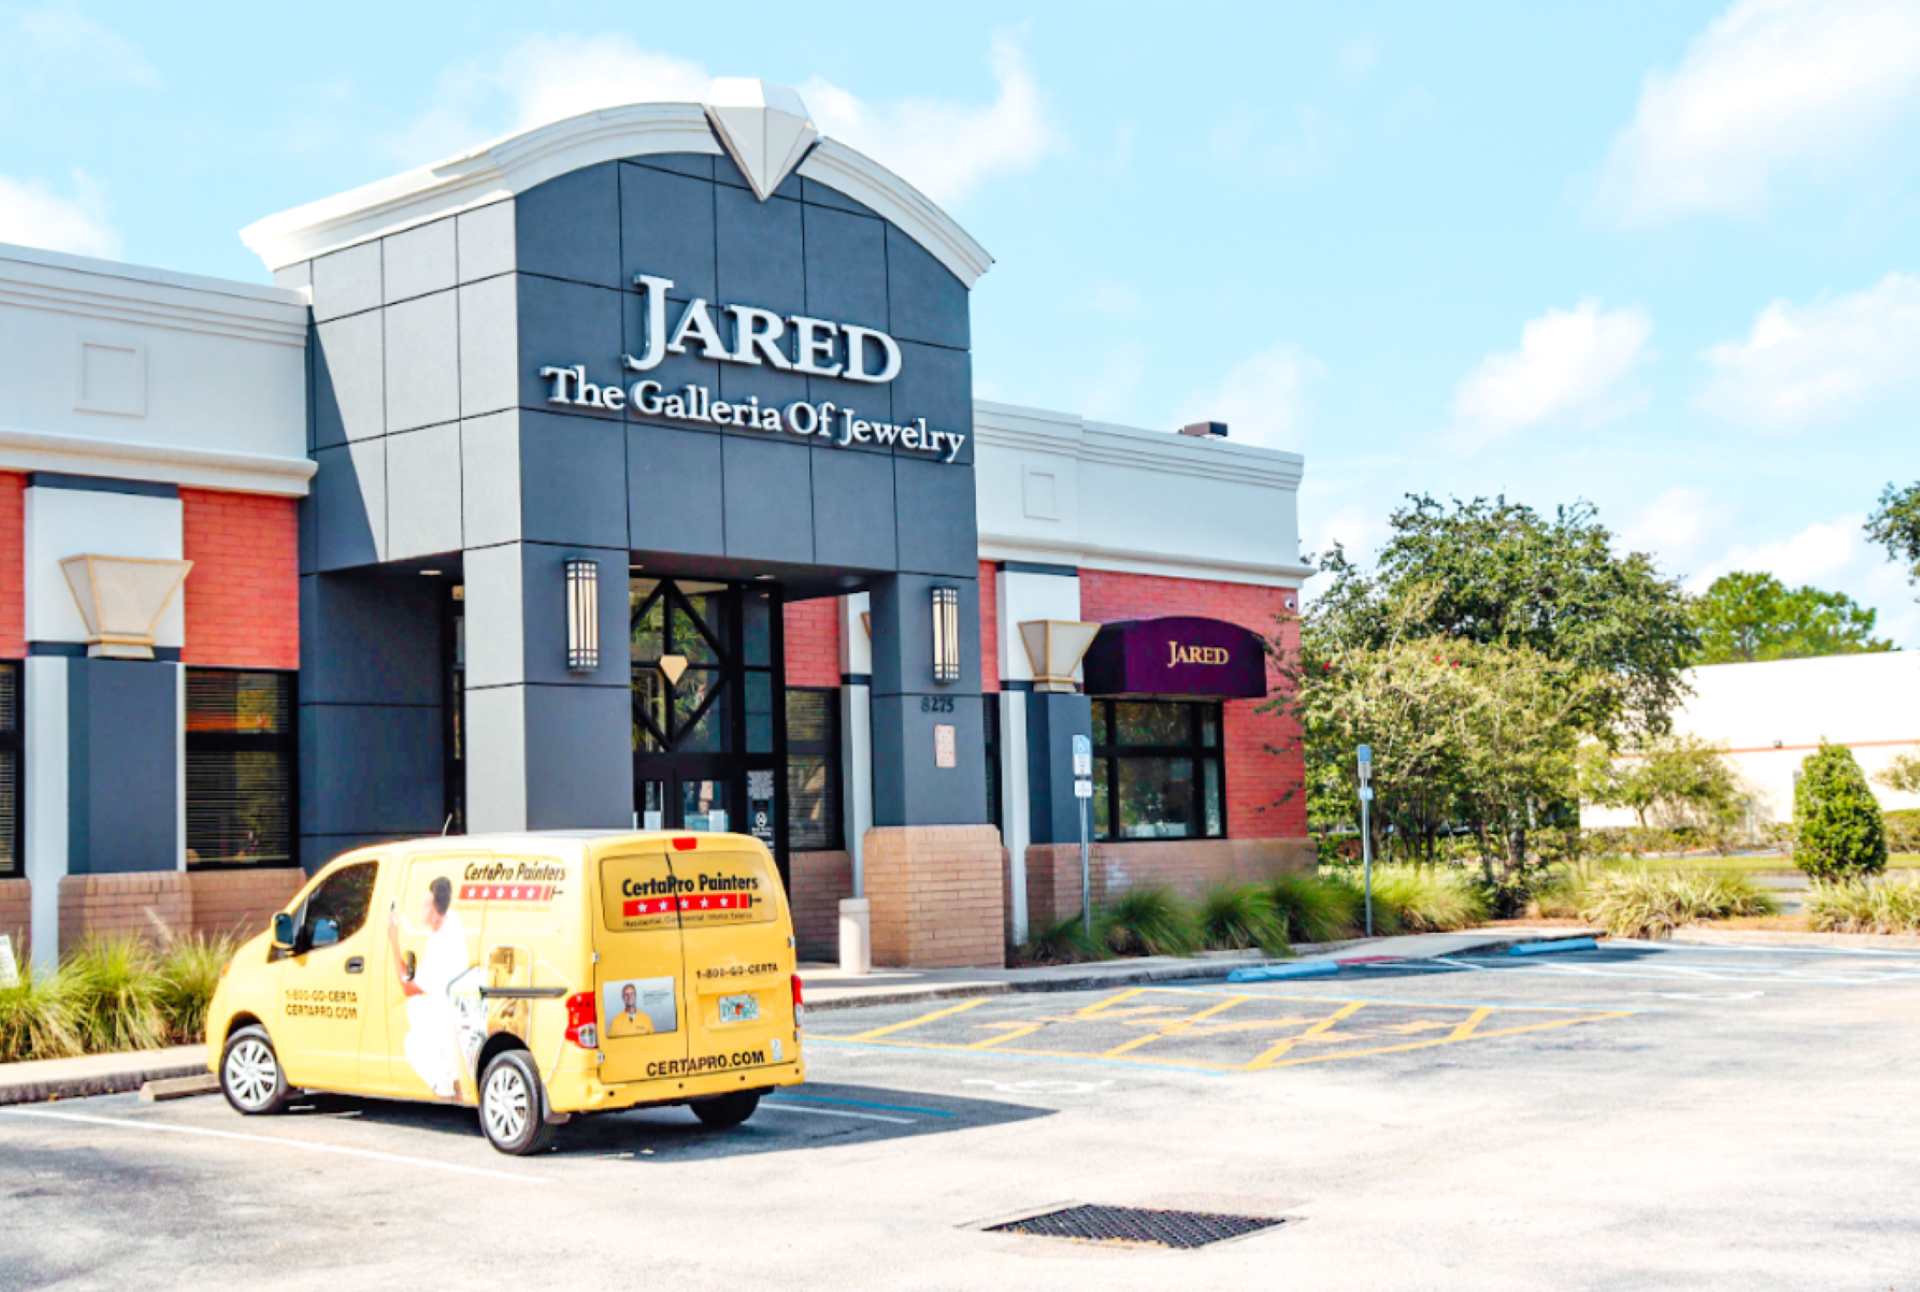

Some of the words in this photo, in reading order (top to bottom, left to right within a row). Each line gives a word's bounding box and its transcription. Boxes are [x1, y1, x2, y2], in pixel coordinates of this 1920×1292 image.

[621, 273, 902, 384] JARED
[540, 365, 626, 410] The
[629, 379, 783, 433] Galleria
[784, 401, 835, 438] Of
[835, 408, 965, 463] Jewelry
[1166, 640, 1230, 668] JARED
[921, 696, 954, 713] 8275
[464, 861, 514, 881] CertaPro
[516, 861, 567, 881] Painters
[622, 874, 694, 897] CertaPro
[698, 872, 759, 891] Painters
[647, 1050, 766, 1077] CERTAPRO.COM
